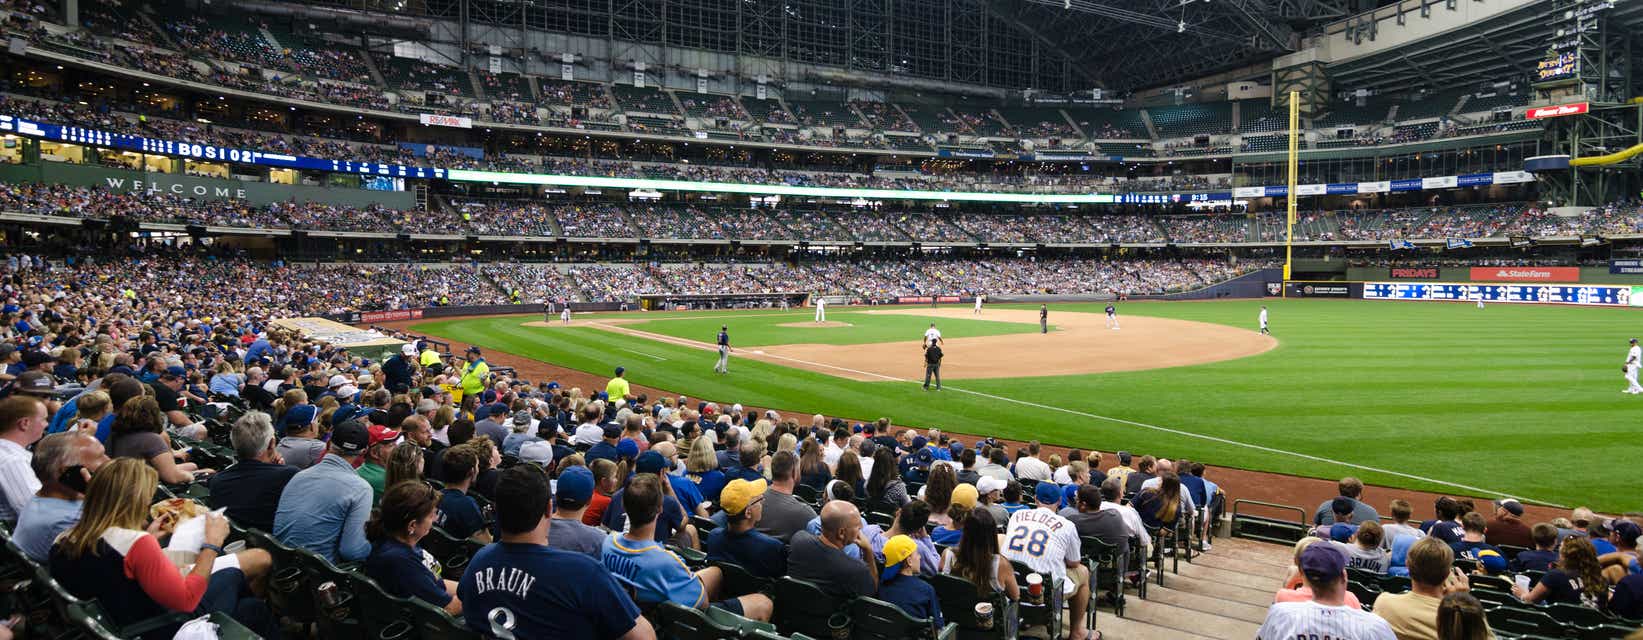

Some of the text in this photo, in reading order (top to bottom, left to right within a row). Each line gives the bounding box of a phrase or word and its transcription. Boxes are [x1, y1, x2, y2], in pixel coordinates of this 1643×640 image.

[105, 177, 246, 199] WELCOME
[1392, 268, 1437, 278] FRIDAYS
[1015, 511, 1064, 532] FIELDER
[1008, 525, 1049, 558] 28
[475, 567, 536, 600] BRAUN
